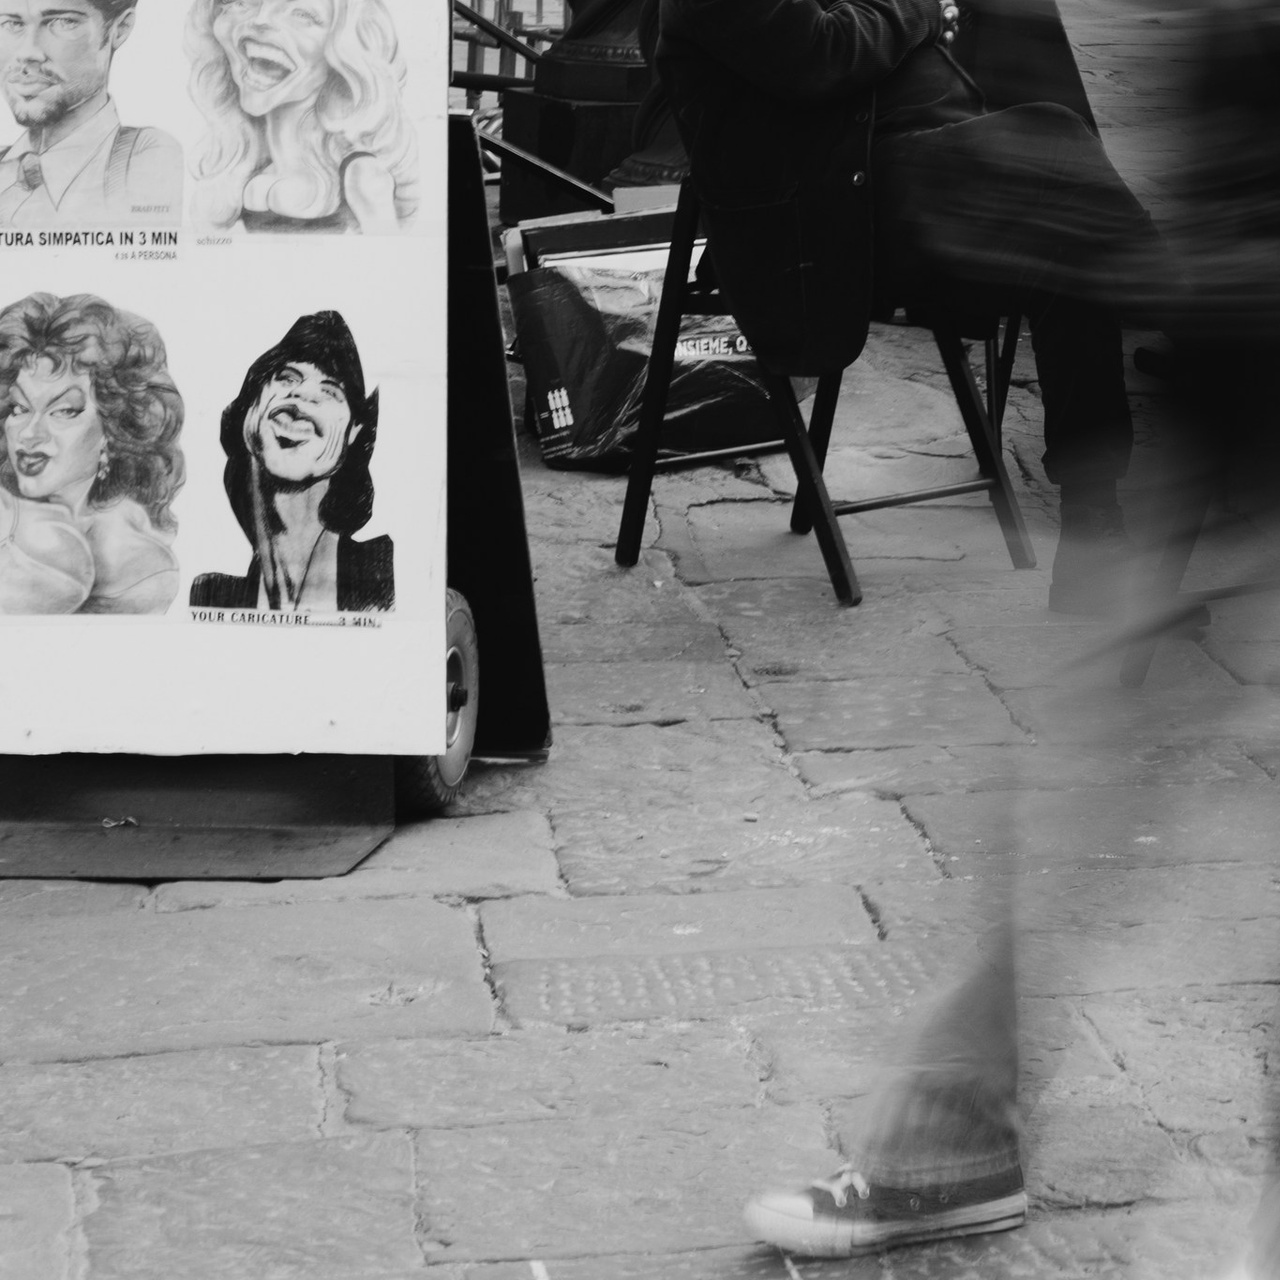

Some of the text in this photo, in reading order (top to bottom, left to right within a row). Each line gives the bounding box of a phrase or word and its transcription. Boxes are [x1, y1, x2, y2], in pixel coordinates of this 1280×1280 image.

[39, 232, 114, 246] SIMPATICA
[119, 232, 134, 246] IN
[138, 232, 147, 246] 3
[151, 232, 178, 246] MIN
[138, 250, 177, 260] PERSONA
[191, 611, 225, 622] YOUR
